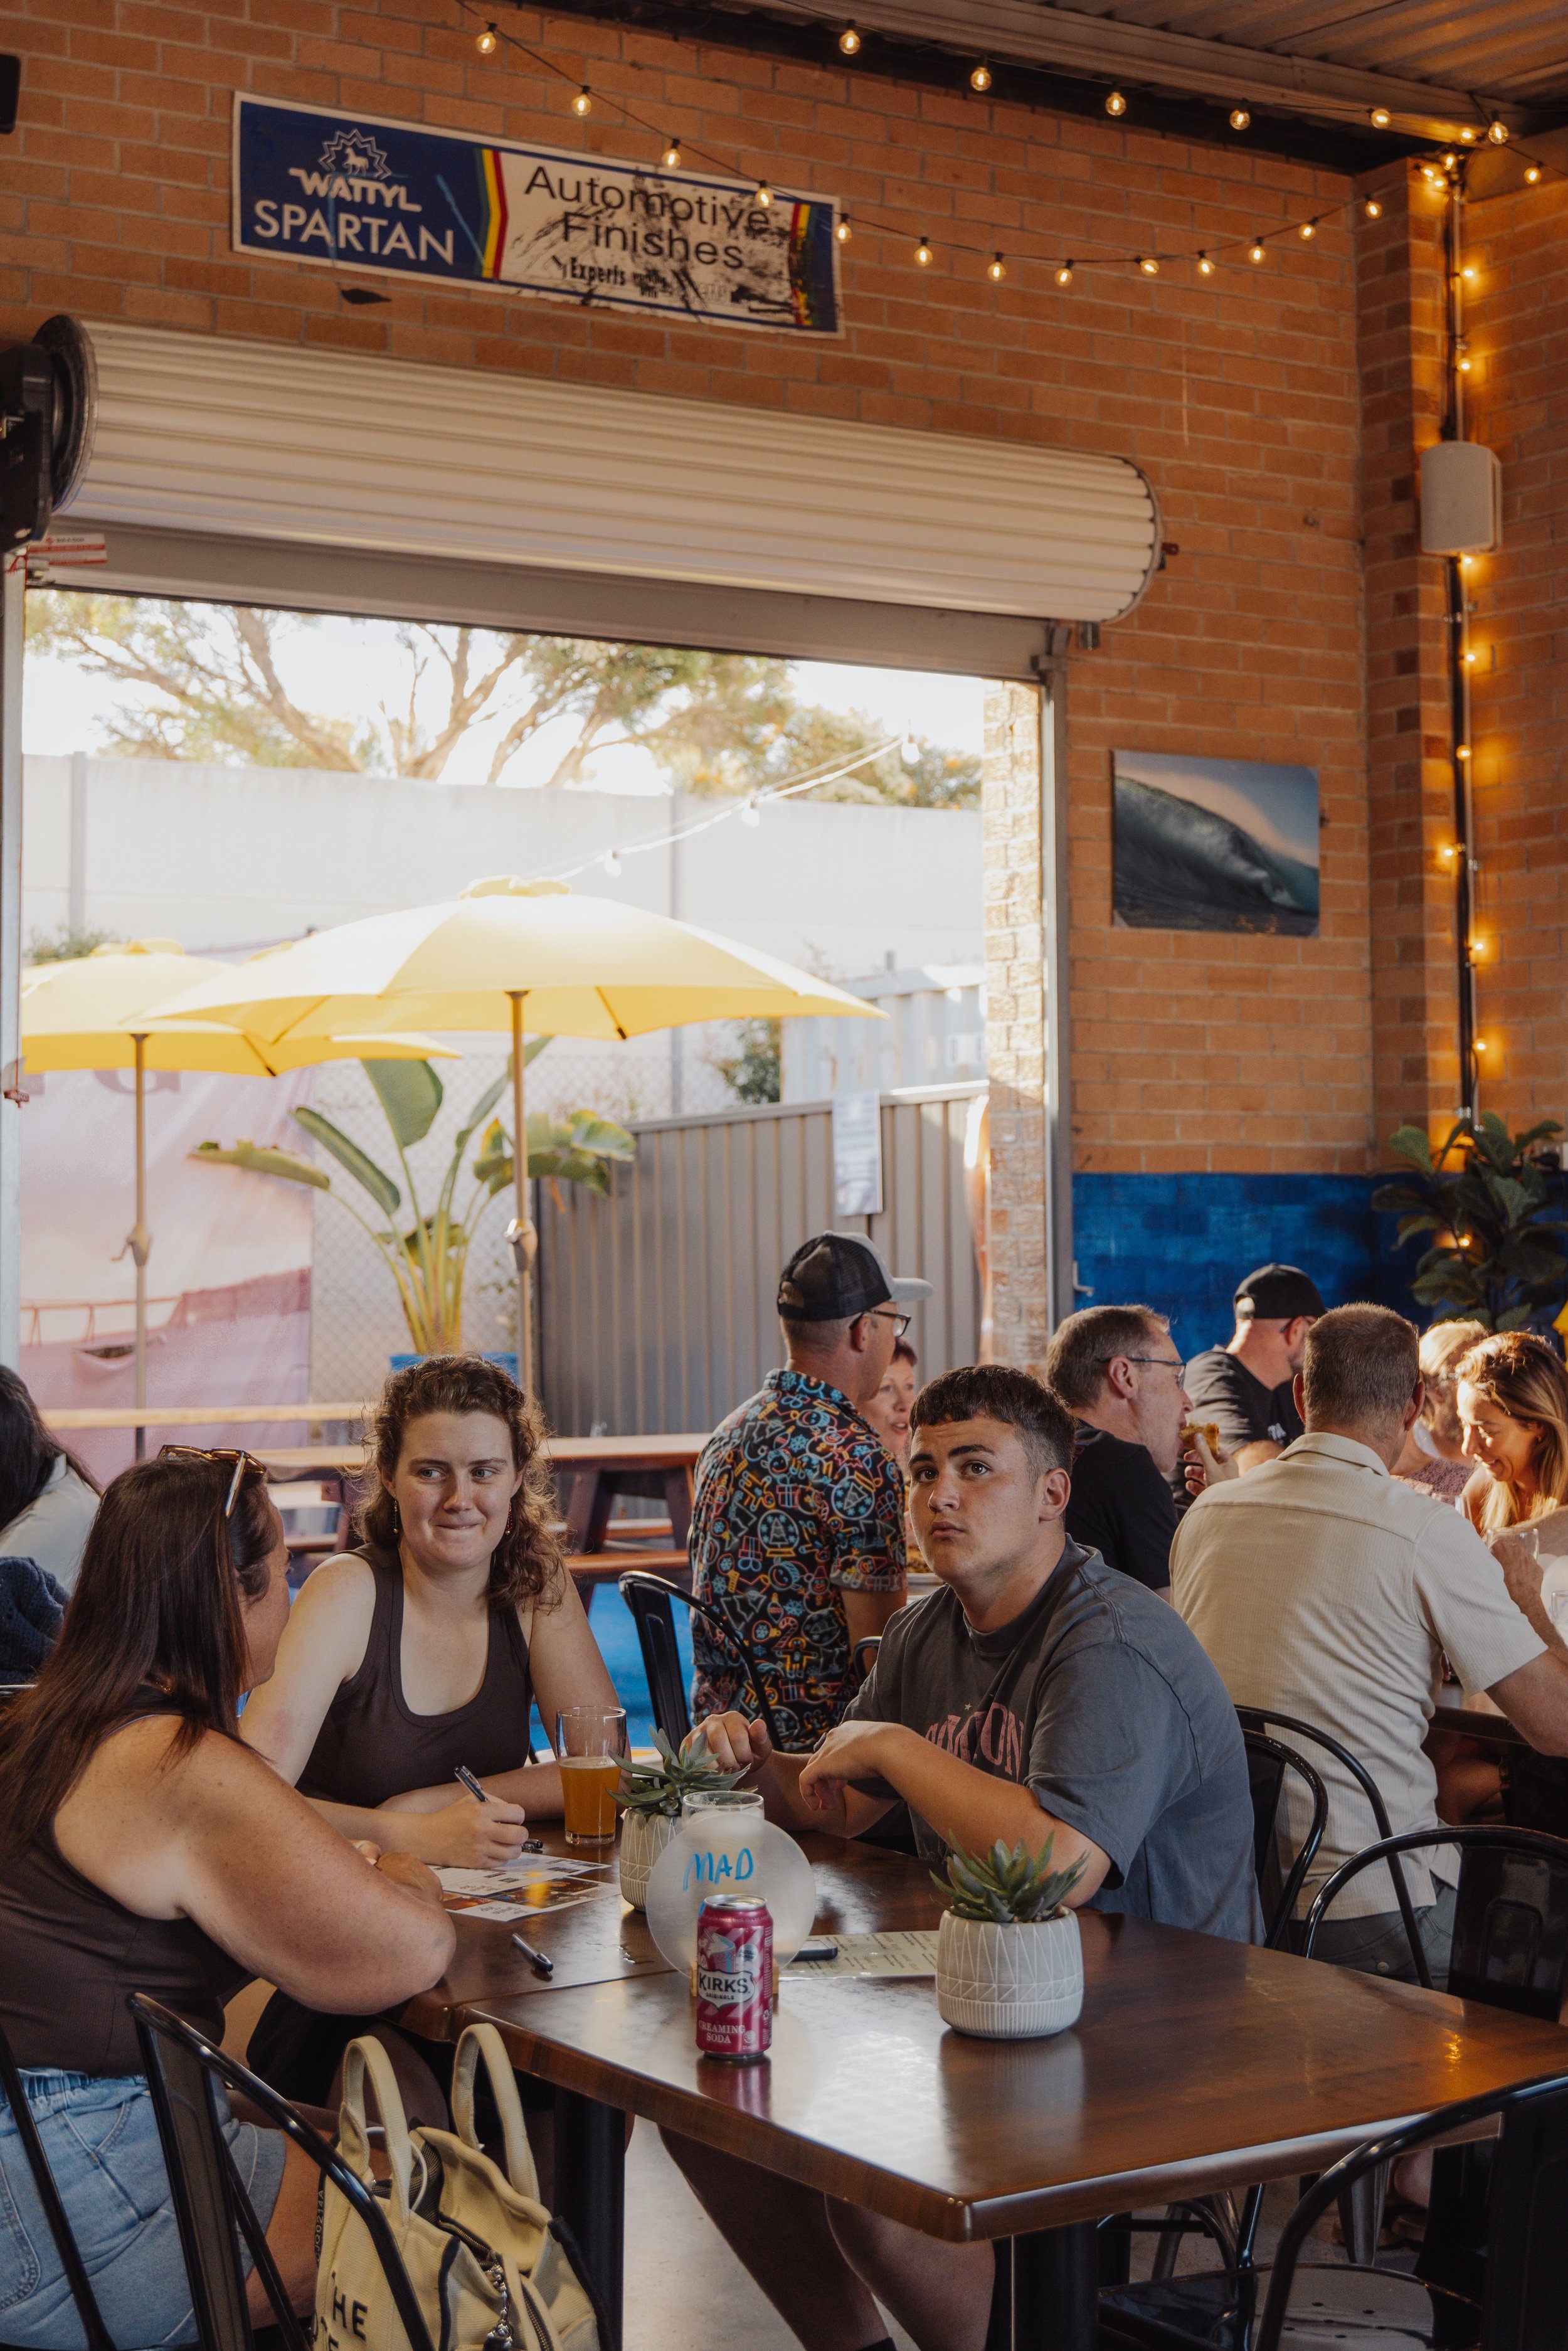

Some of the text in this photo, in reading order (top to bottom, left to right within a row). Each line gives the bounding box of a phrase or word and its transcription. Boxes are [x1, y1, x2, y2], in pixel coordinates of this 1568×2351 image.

[288, 167, 422, 213] WATTYL
[524, 166, 771, 230] Automotive
[254, 199, 454, 265] SPARTAN
[564, 211, 743, 270] Finishes
[571, 257, 626, 286] Experts
[682, 1847, 755, 1891] MAD
[699, 1972, 749, 1993] KIRKS
[699, 2020, 746, 2034] CREAMING
[706, 2032, 731, 2043] SODA
[332, 2271, 369, 2342] HE
